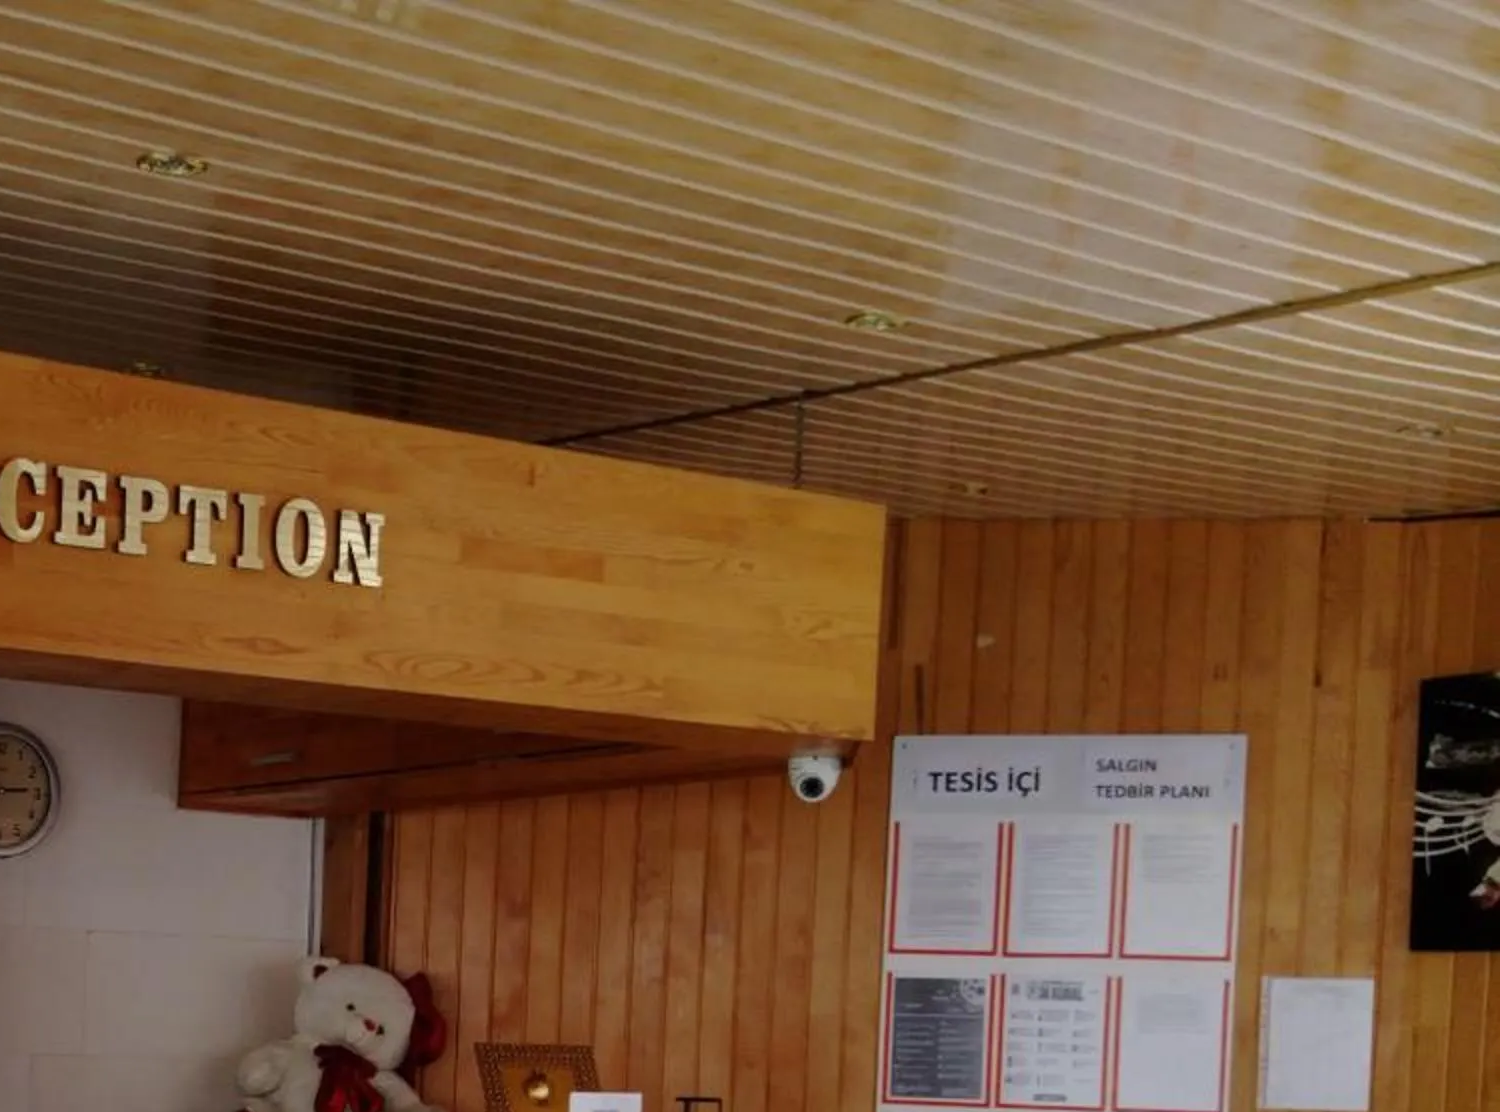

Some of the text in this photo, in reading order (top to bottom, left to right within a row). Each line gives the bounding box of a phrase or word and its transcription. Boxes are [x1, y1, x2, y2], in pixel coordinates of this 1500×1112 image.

[1095, 758, 1157, 773] SALGIN
[928, 767, 1041, 797] TESİS İÇİ
[1095, 783, 1211, 799] TEDBİR PLANI
